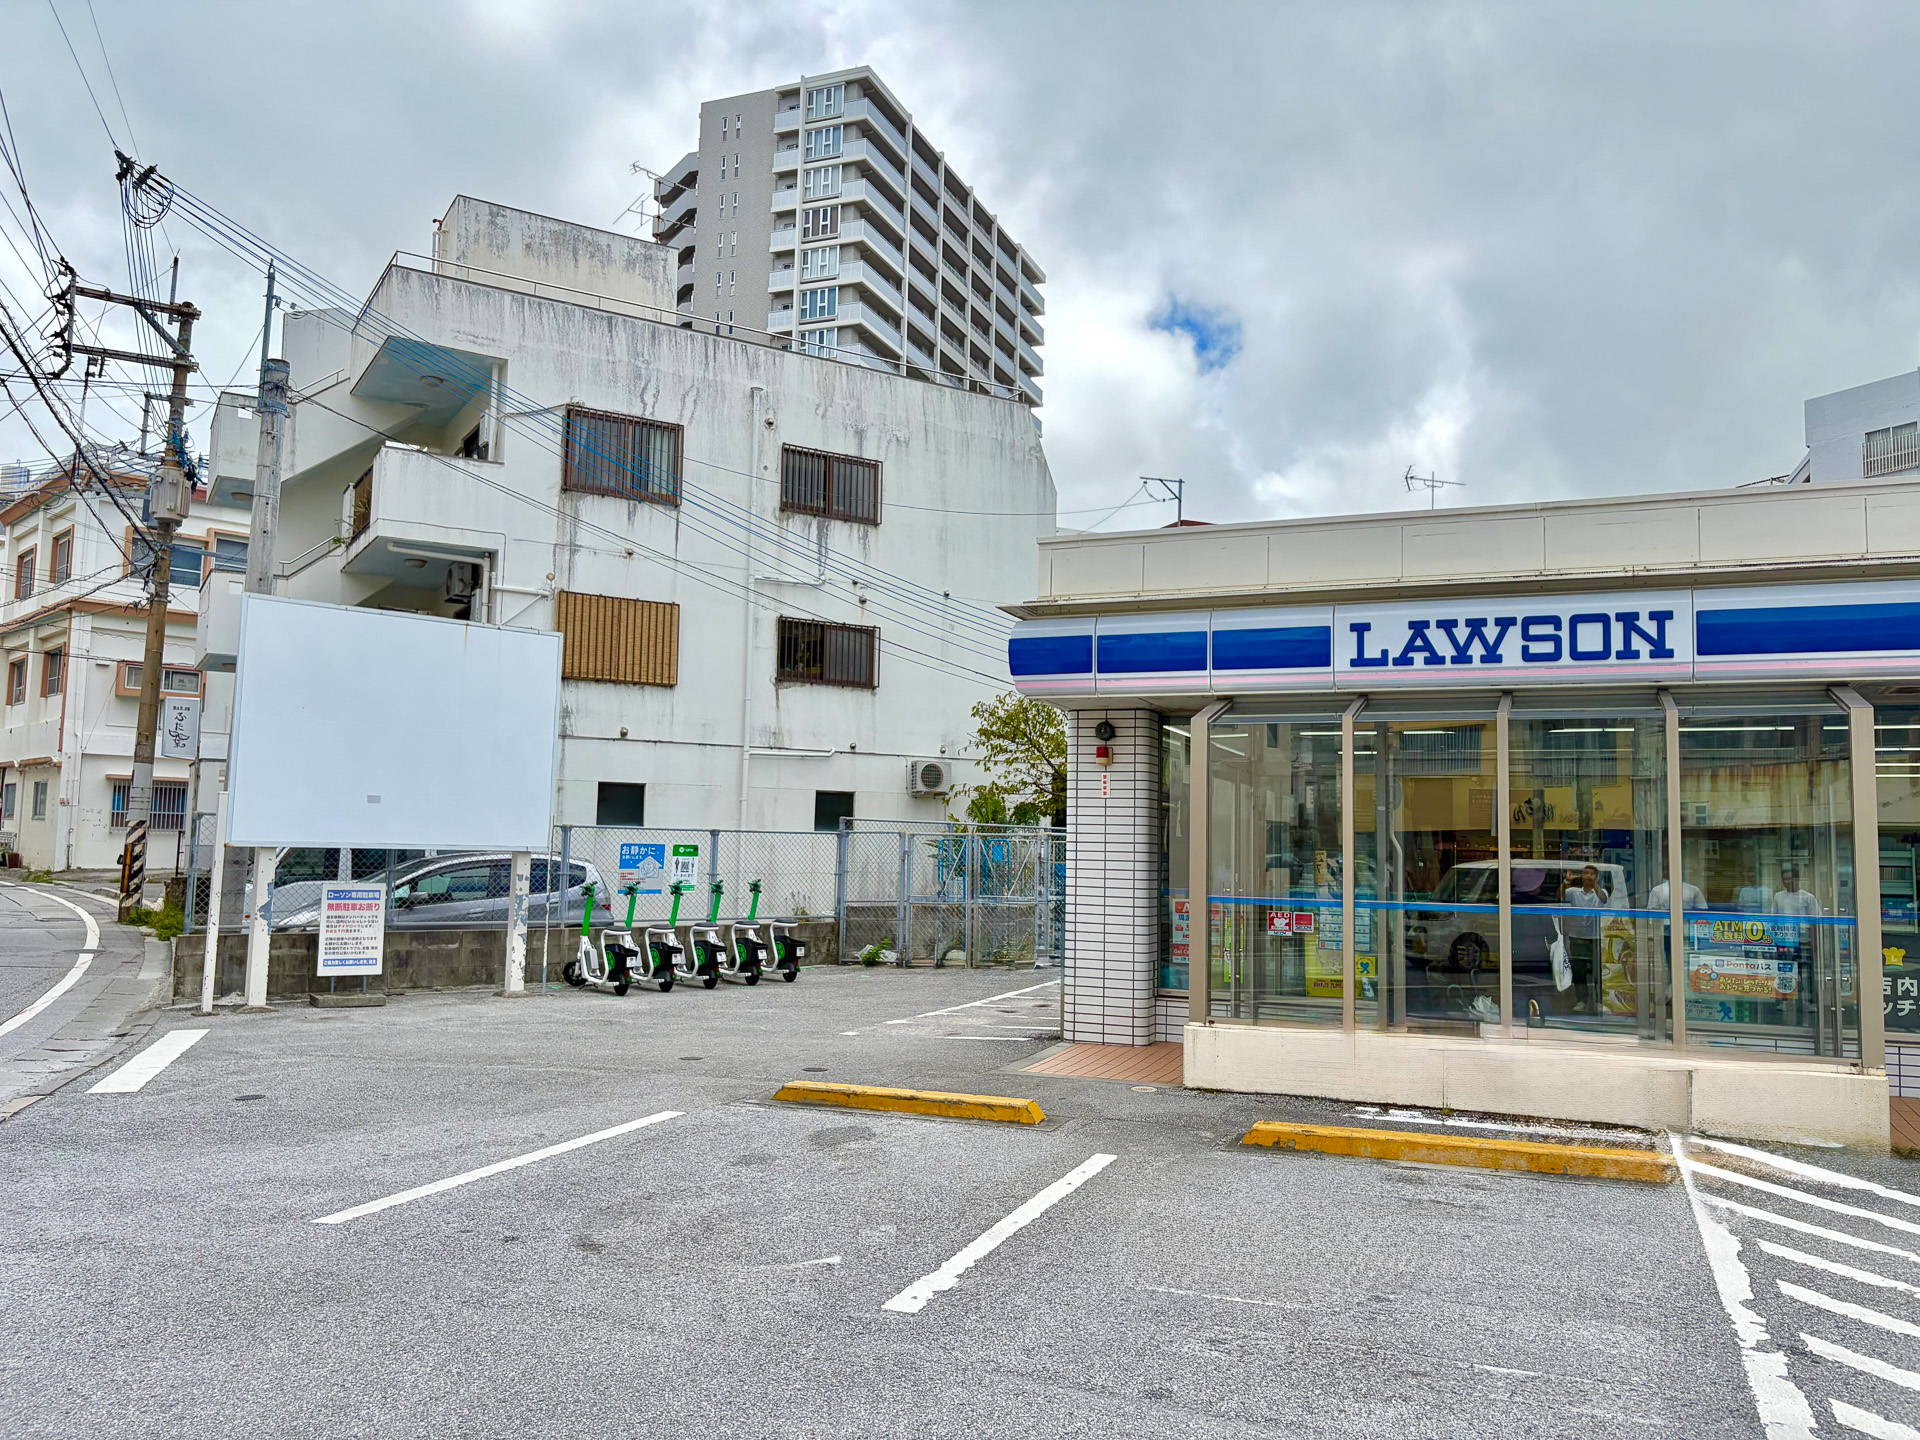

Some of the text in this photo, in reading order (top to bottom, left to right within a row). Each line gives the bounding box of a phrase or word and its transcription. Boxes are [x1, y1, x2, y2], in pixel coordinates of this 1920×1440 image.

[1350, 610, 1674, 667] LAWSON
[622, 846, 656, 855] お静かに
[327, 902, 380, 912] 無断駐車お断り
[1713, 920, 1743, 931] ATM
[1713, 931, 1743, 941] 手数料
